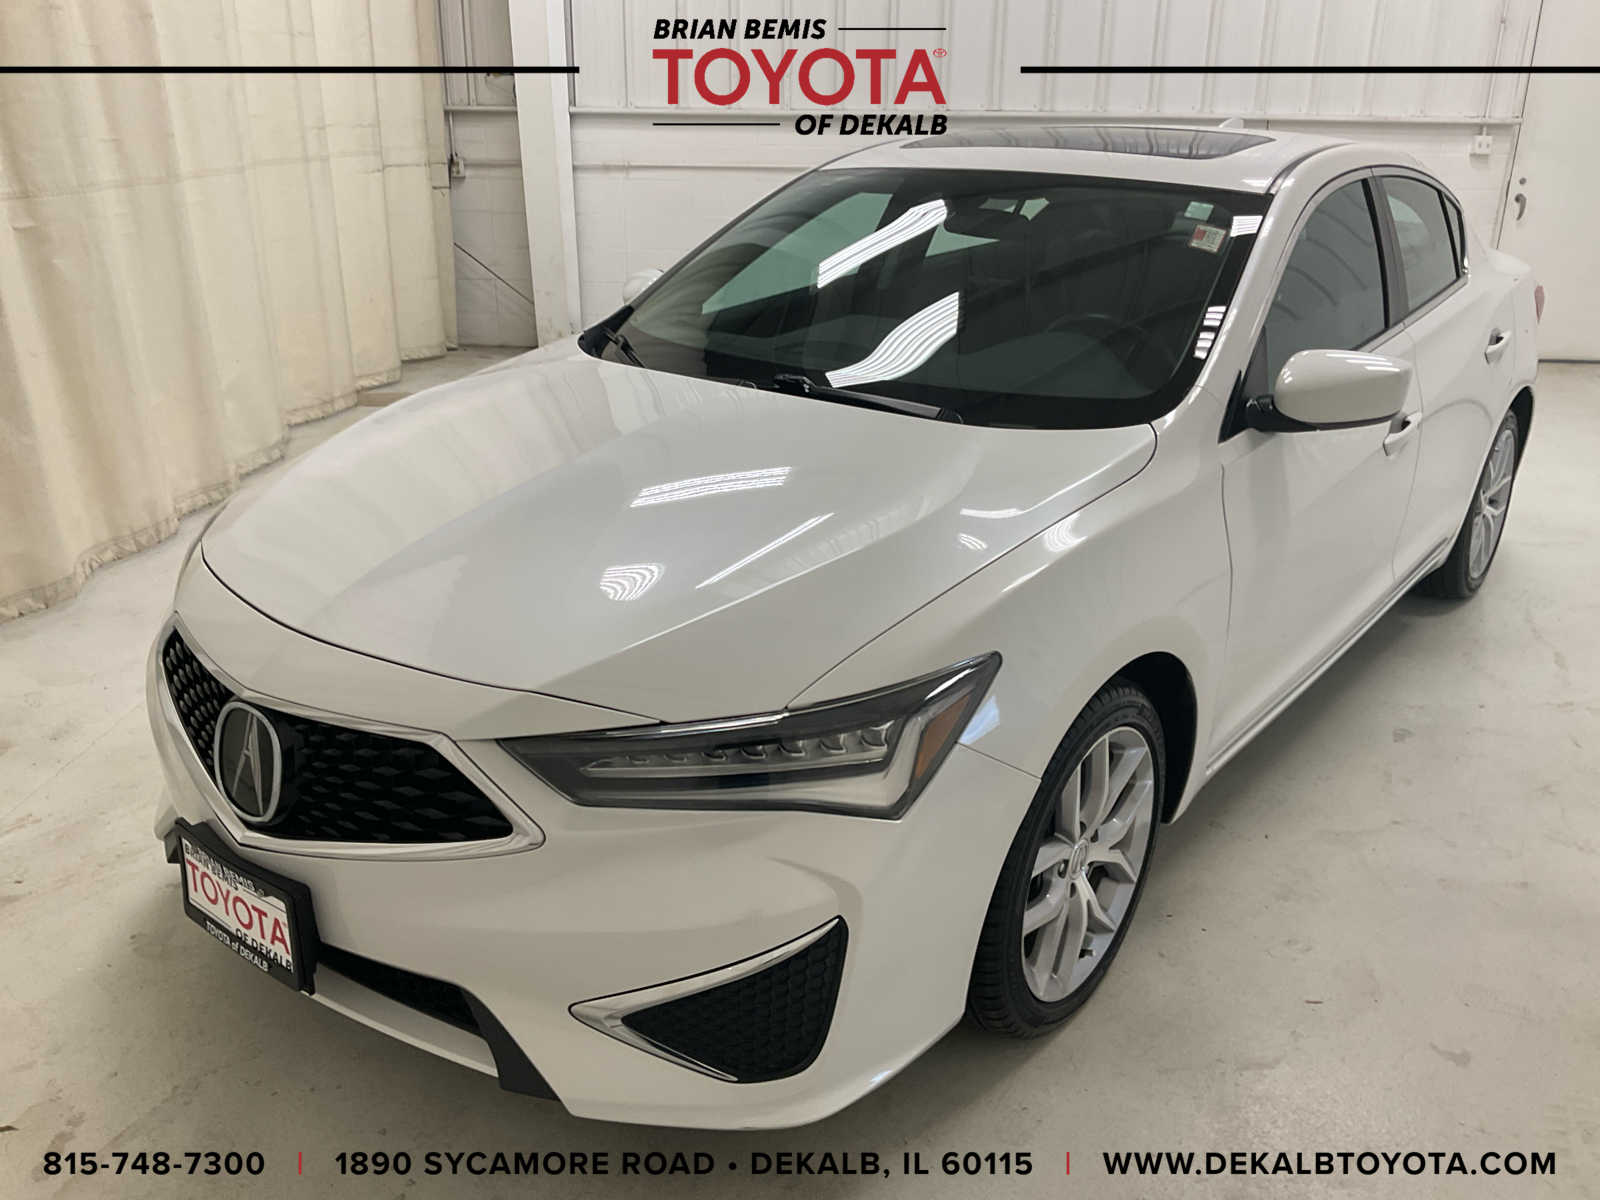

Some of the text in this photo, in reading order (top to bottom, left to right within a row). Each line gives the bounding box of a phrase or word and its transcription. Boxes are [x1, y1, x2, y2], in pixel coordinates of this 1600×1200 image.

[186, 858, 291, 956] TOYOTA
[206, 920, 231, 945] TOYOTA
[239, 945, 269, 972] DEKALB
[251, 938, 292, 970] DEKALB
